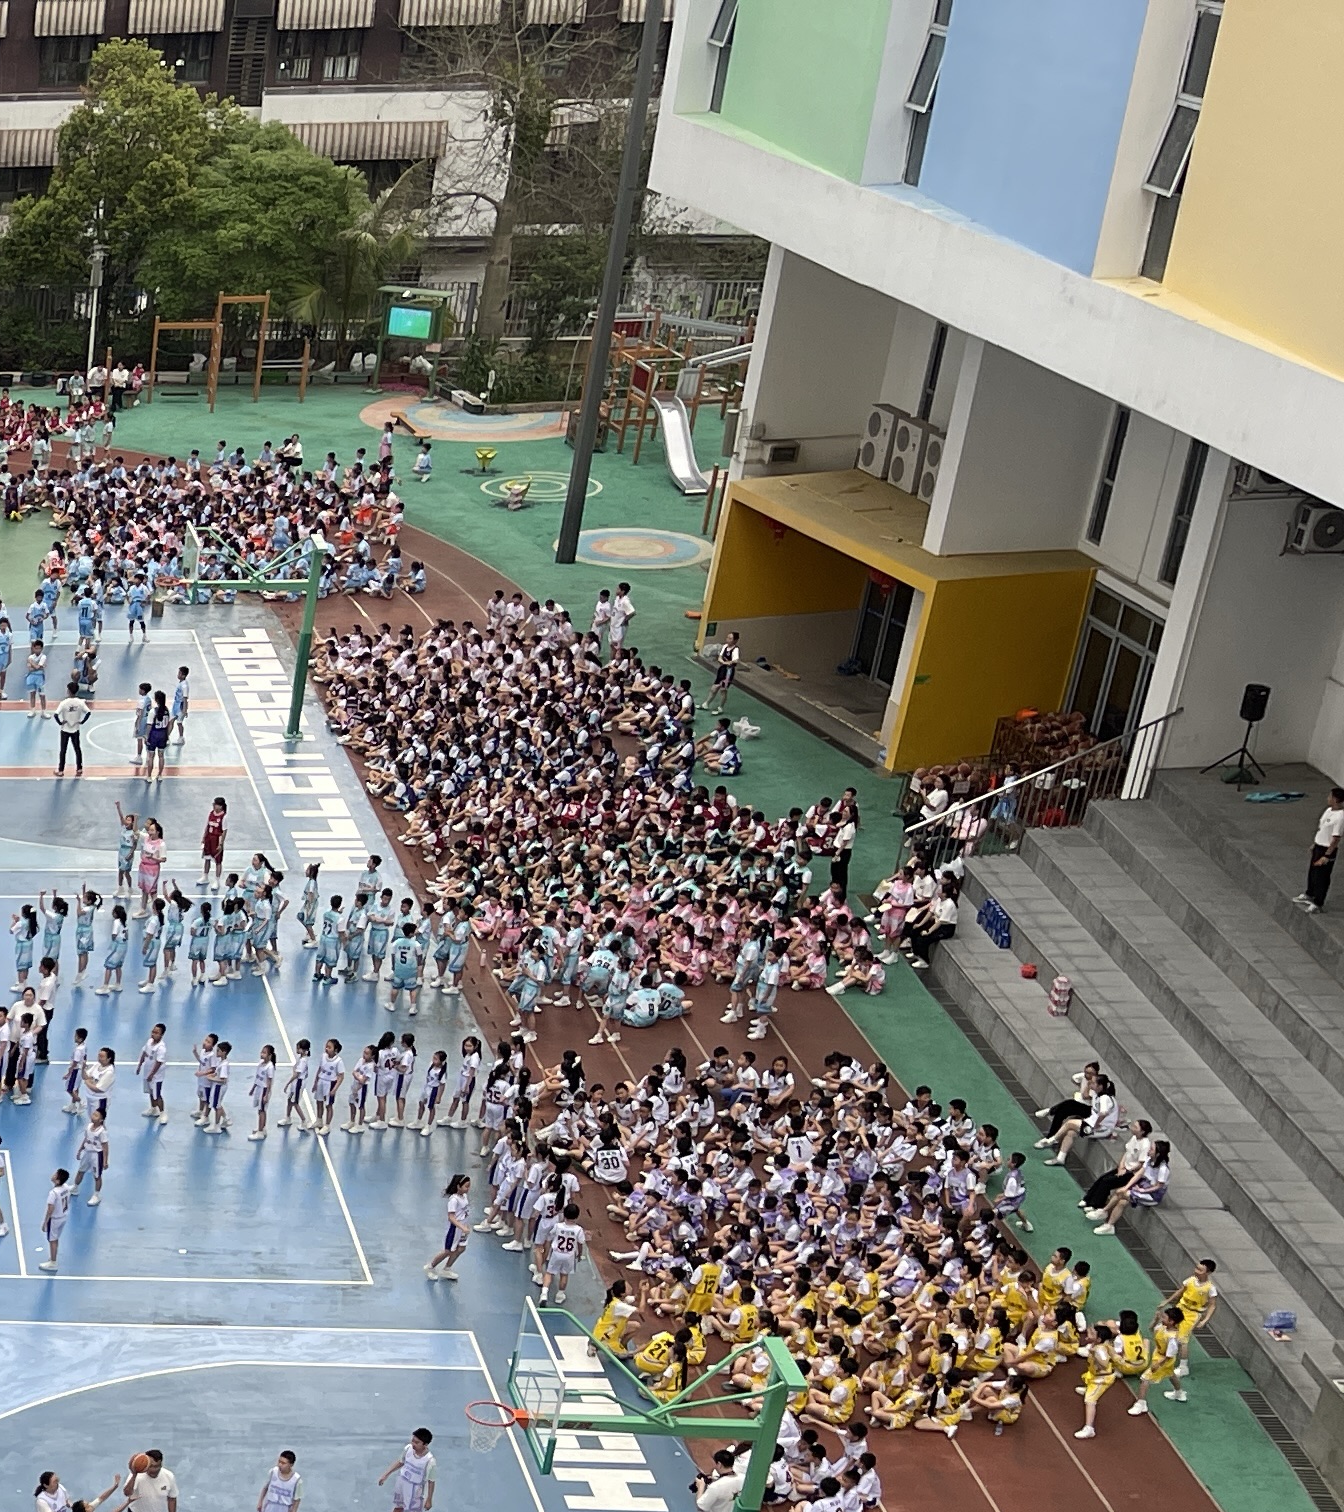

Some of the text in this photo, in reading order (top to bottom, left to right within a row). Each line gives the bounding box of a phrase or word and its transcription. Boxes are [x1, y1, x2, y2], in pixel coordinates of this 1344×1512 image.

[602, 1156, 619, 1170] 30
[558, 1236, 574, 1250] 26
[649, 1343, 668, 1360] 21
[1134, 1345, 1144, 1361] 2
